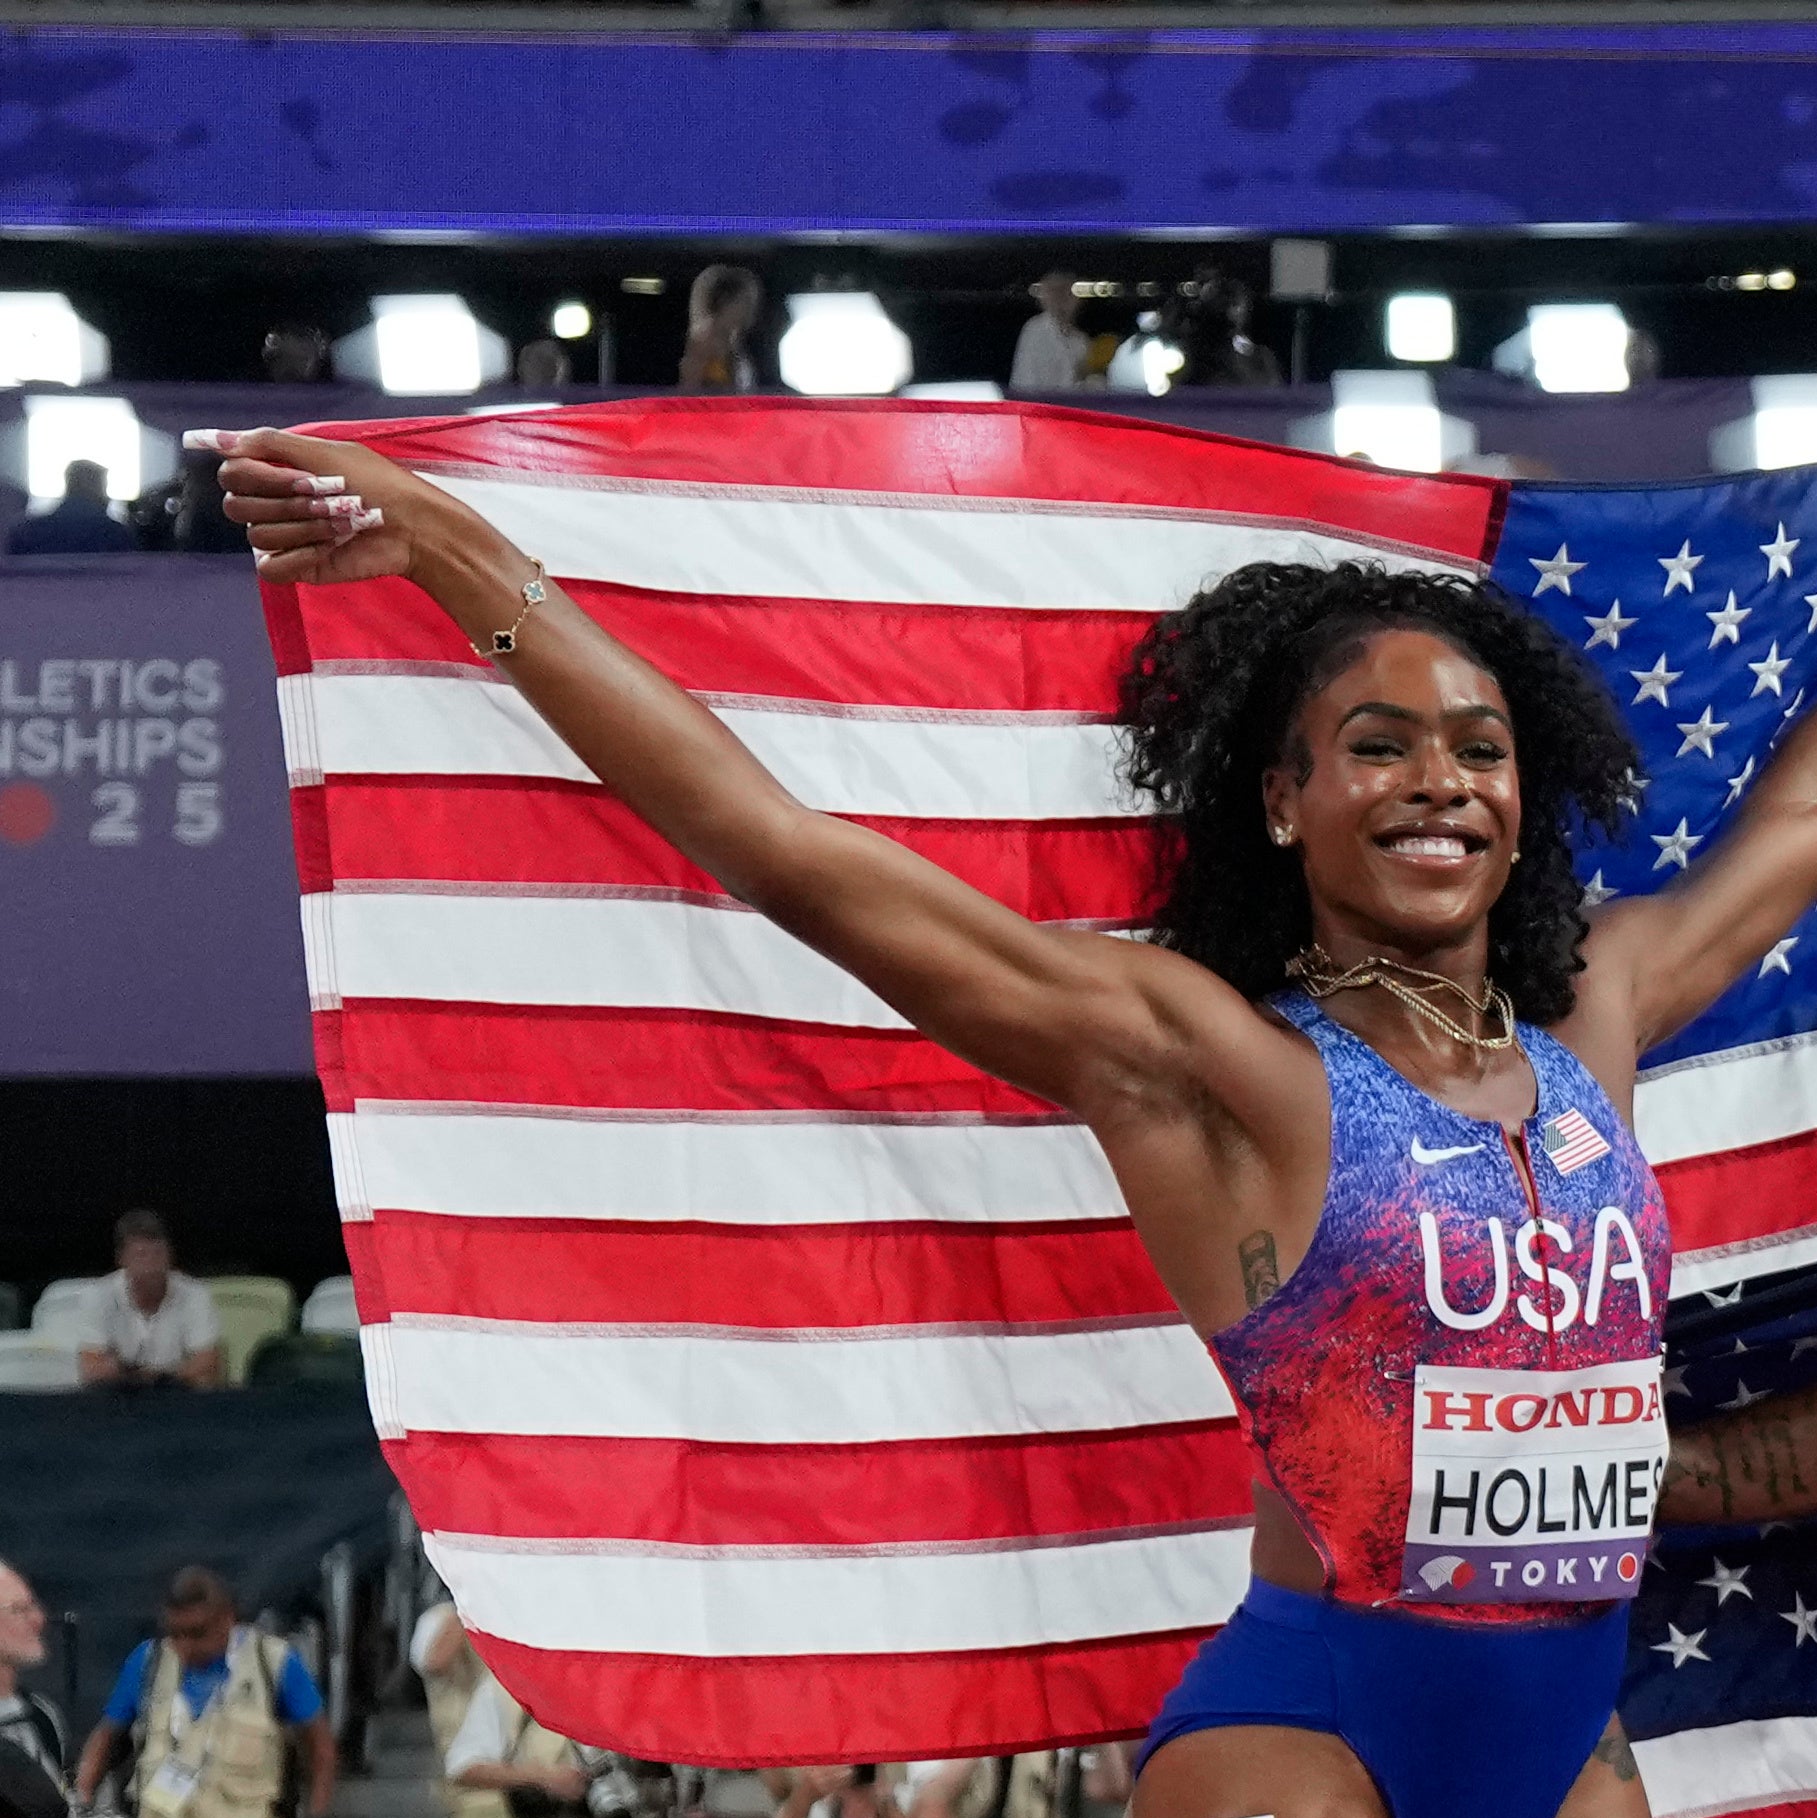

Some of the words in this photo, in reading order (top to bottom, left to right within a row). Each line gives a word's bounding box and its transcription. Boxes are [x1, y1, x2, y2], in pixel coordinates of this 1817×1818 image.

[1420, 1206, 1651, 1332] USA
[1422, 1382, 1662, 1433] HONDA
[1490, 1552, 1638, 1588] TOKYO
